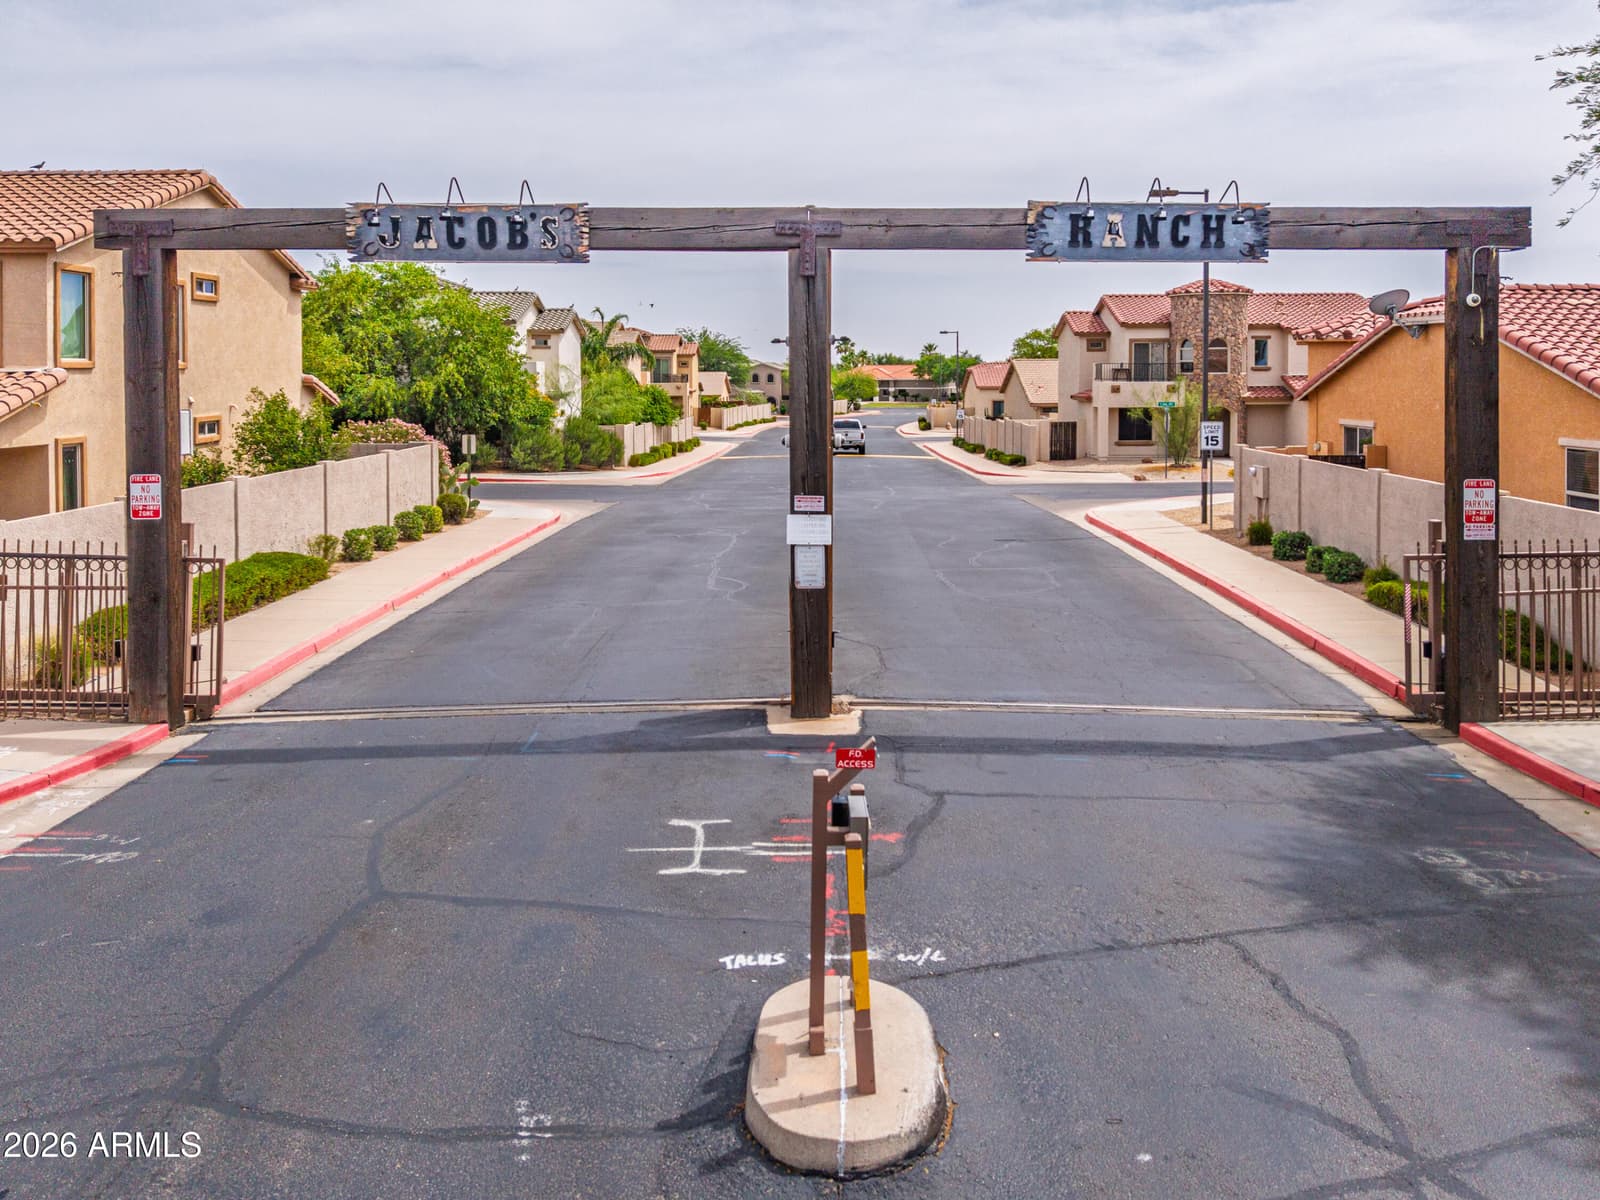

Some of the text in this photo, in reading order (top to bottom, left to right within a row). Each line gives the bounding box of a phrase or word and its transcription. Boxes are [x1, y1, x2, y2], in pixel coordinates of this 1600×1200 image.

[377, 212, 560, 249] JACOB'S
[1068, 213, 1226, 248] RANCH
[1204, 435, 1219, 446] 15
[140, 485, 151, 493] NO
[131, 494, 160, 503] PARKING
[1474, 490, 1485, 499] NO
[1465, 500, 1494, 508] PARKING
[837, 760, 874, 768] ACCESS
